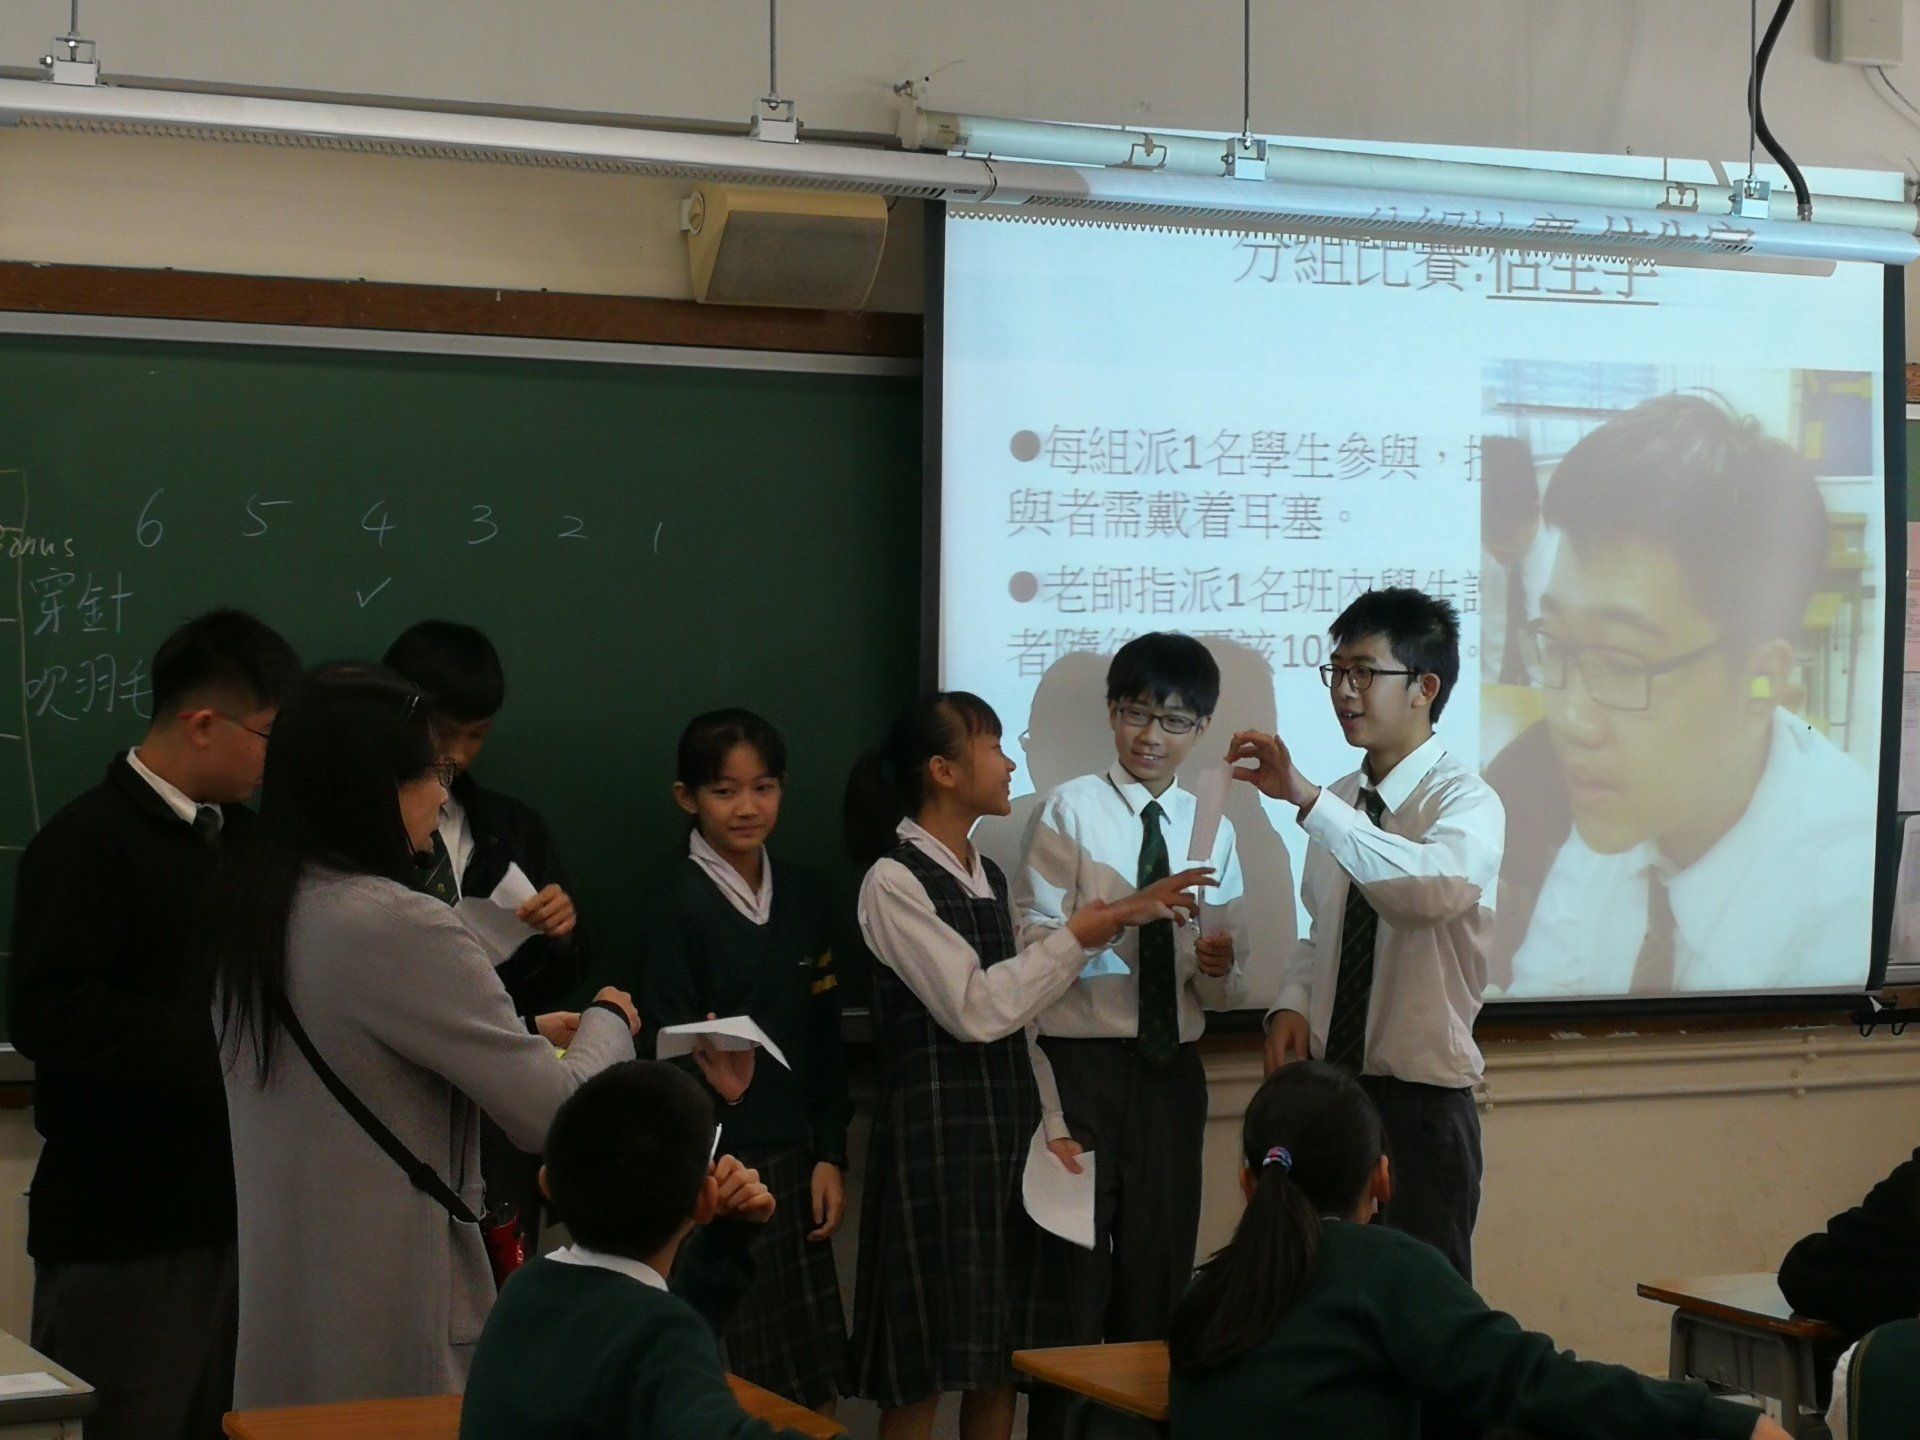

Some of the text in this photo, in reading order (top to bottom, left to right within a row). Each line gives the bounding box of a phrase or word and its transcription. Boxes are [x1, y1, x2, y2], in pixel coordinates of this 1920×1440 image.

[136, 488, 164, 548] 6
[242, 494, 292, 537] 5
[361, 500, 396, 547] 4
[467, 504, 499, 545] 3
[558, 515, 588, 539] 2
[26, 653, 152, 721] 吹羽毛
